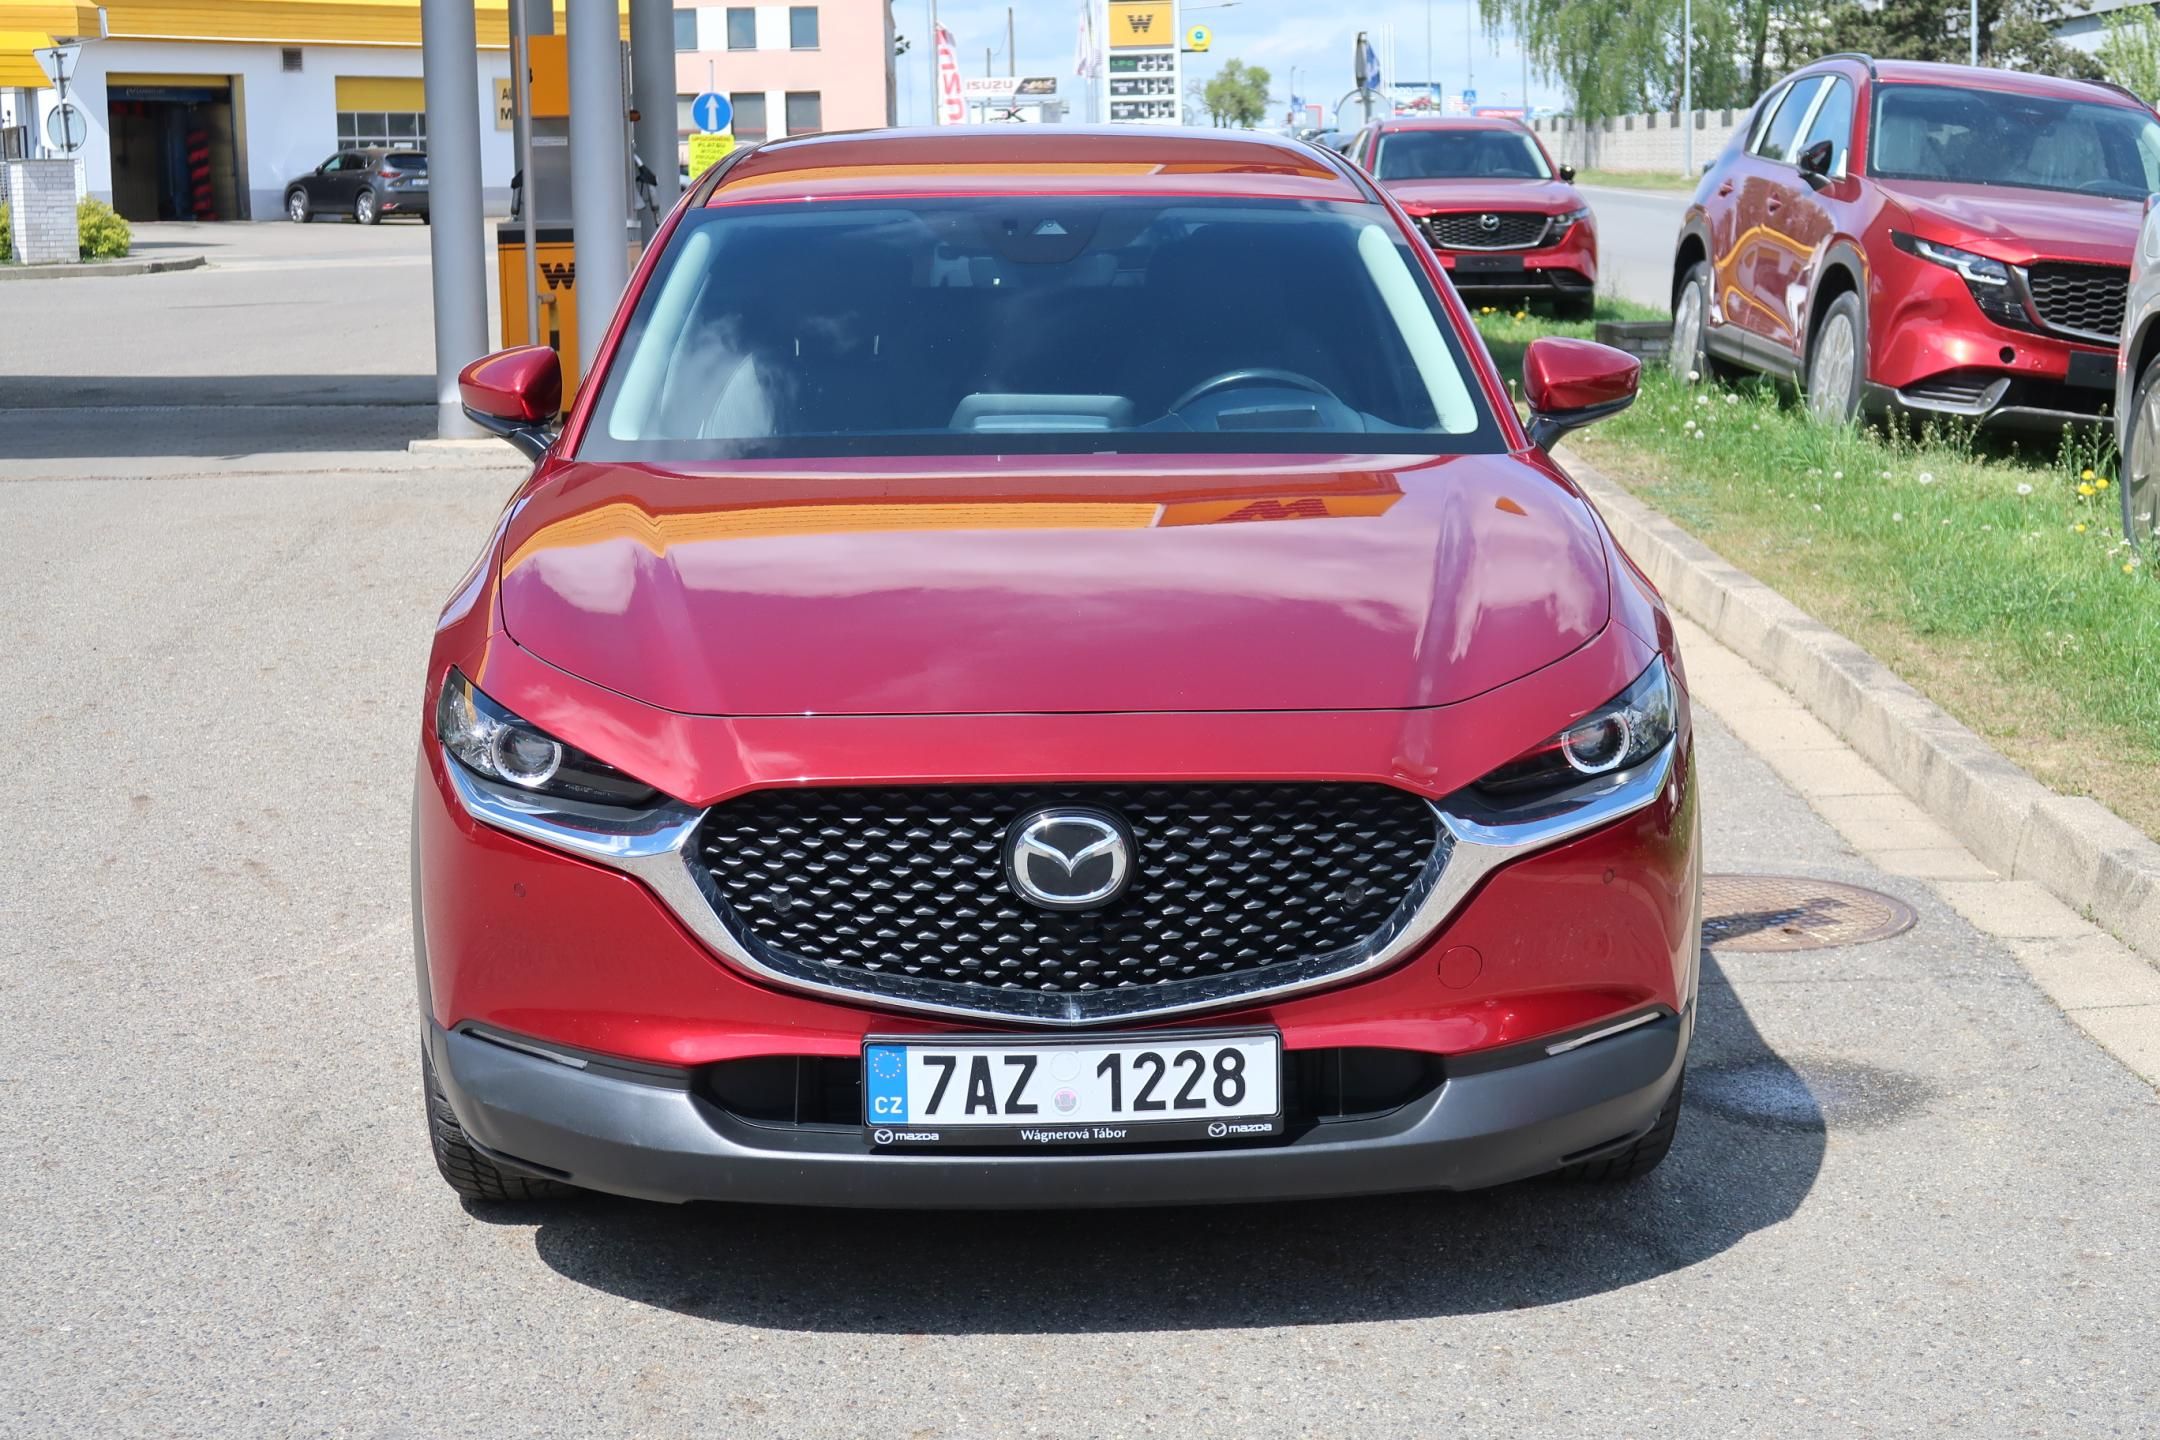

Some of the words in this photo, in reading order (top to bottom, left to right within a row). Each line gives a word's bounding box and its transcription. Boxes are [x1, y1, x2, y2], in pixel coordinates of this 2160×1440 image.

[966, 80, 1013, 91] ISUZU
[923, 1054, 1039, 1115] 7AZ
[1096, 1047, 1246, 1113] 1228
[874, 1096, 903, 1114] CZ
[1020, 1128, 1090, 1143] Wágnerová
[1092, 1127, 1127, 1139] Tábor
